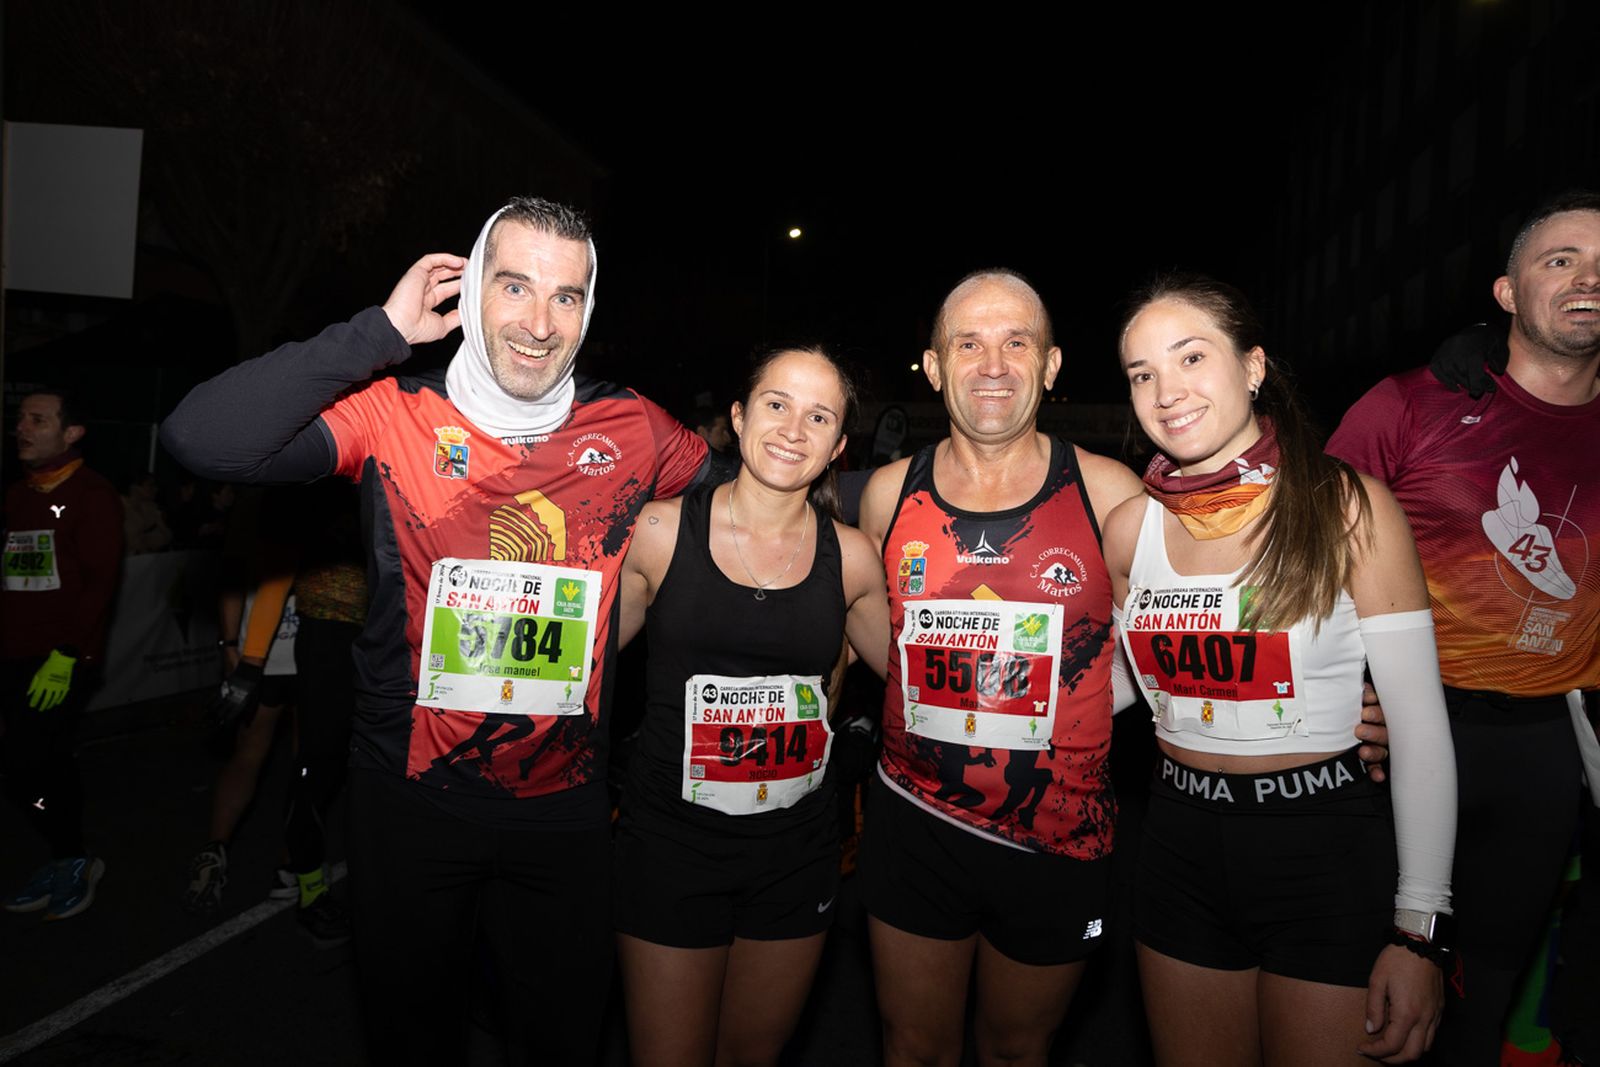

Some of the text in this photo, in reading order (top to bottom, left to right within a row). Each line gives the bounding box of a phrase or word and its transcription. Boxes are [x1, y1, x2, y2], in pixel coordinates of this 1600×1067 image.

[572, 432, 622, 460] CORRECAMINOS
[578, 462, 616, 476] Martos
[956, 555, 1010, 564] Vulkano
[1508, 533, 1552, 573] 43
[1038, 547, 1088, 582] CORRECAMINOS
[469, 576, 517, 592] NOCHE
[523, 580, 542, 596] DE
[1037, 578, 1082, 598] Martos
[446, 592, 482, 609] SAN
[1152, 594, 1223, 609] NOCHE DE
[920, 613, 932, 624] 43
[936, 616, 1000, 631] NOCHE DE
[1134, 609, 1222, 630] SAN ANTÓN
[460, 612, 563, 663] 5784
[1522, 622, 1554, 637] SAN
[915, 633, 946, 645] SAN
[946, 630, 999, 650] ANTÓN
[1151, 634, 1256, 682] 6407
[504, 666, 540, 676] manuel
[703, 687, 717, 699] 43
[720, 691, 784, 704] NOCHE DE
[1200, 685, 1238, 697] Carmen
[703, 708, 732, 722] SAN
[736, 704, 785, 723] ANTÓN
[721, 724, 807, 767] 9414
[1162, 758, 1354, 803] PUMA PUMA
